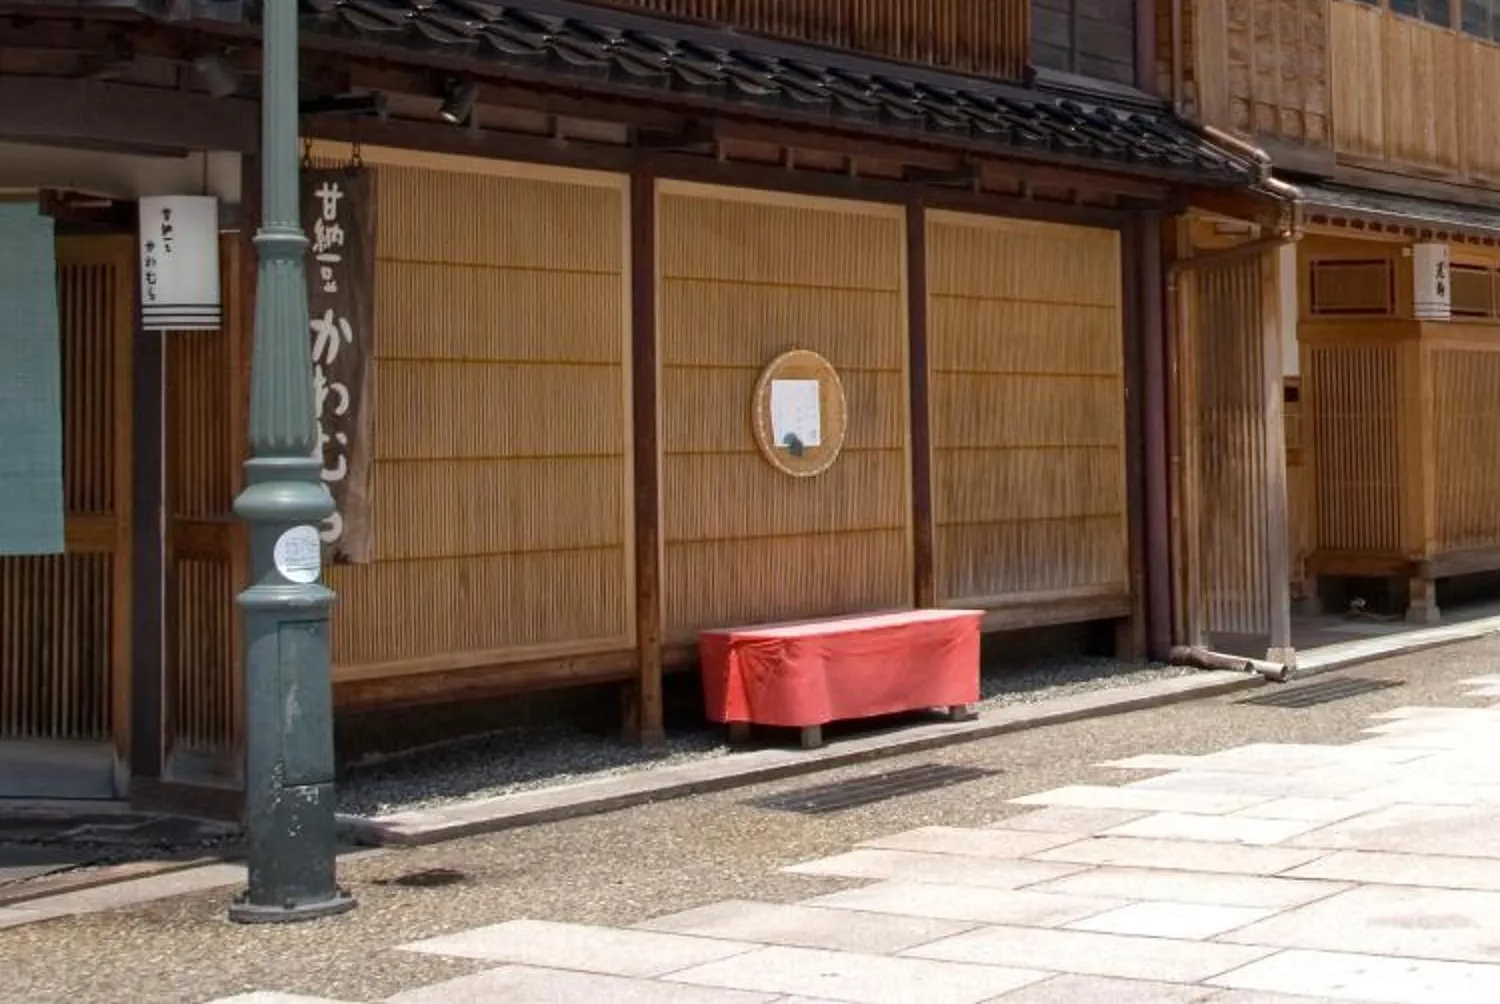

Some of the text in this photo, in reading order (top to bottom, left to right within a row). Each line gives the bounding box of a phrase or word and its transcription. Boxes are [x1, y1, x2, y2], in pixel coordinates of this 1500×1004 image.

[144, 239, 158, 301] かわむら
[312, 182, 346, 293] 甘納豆
